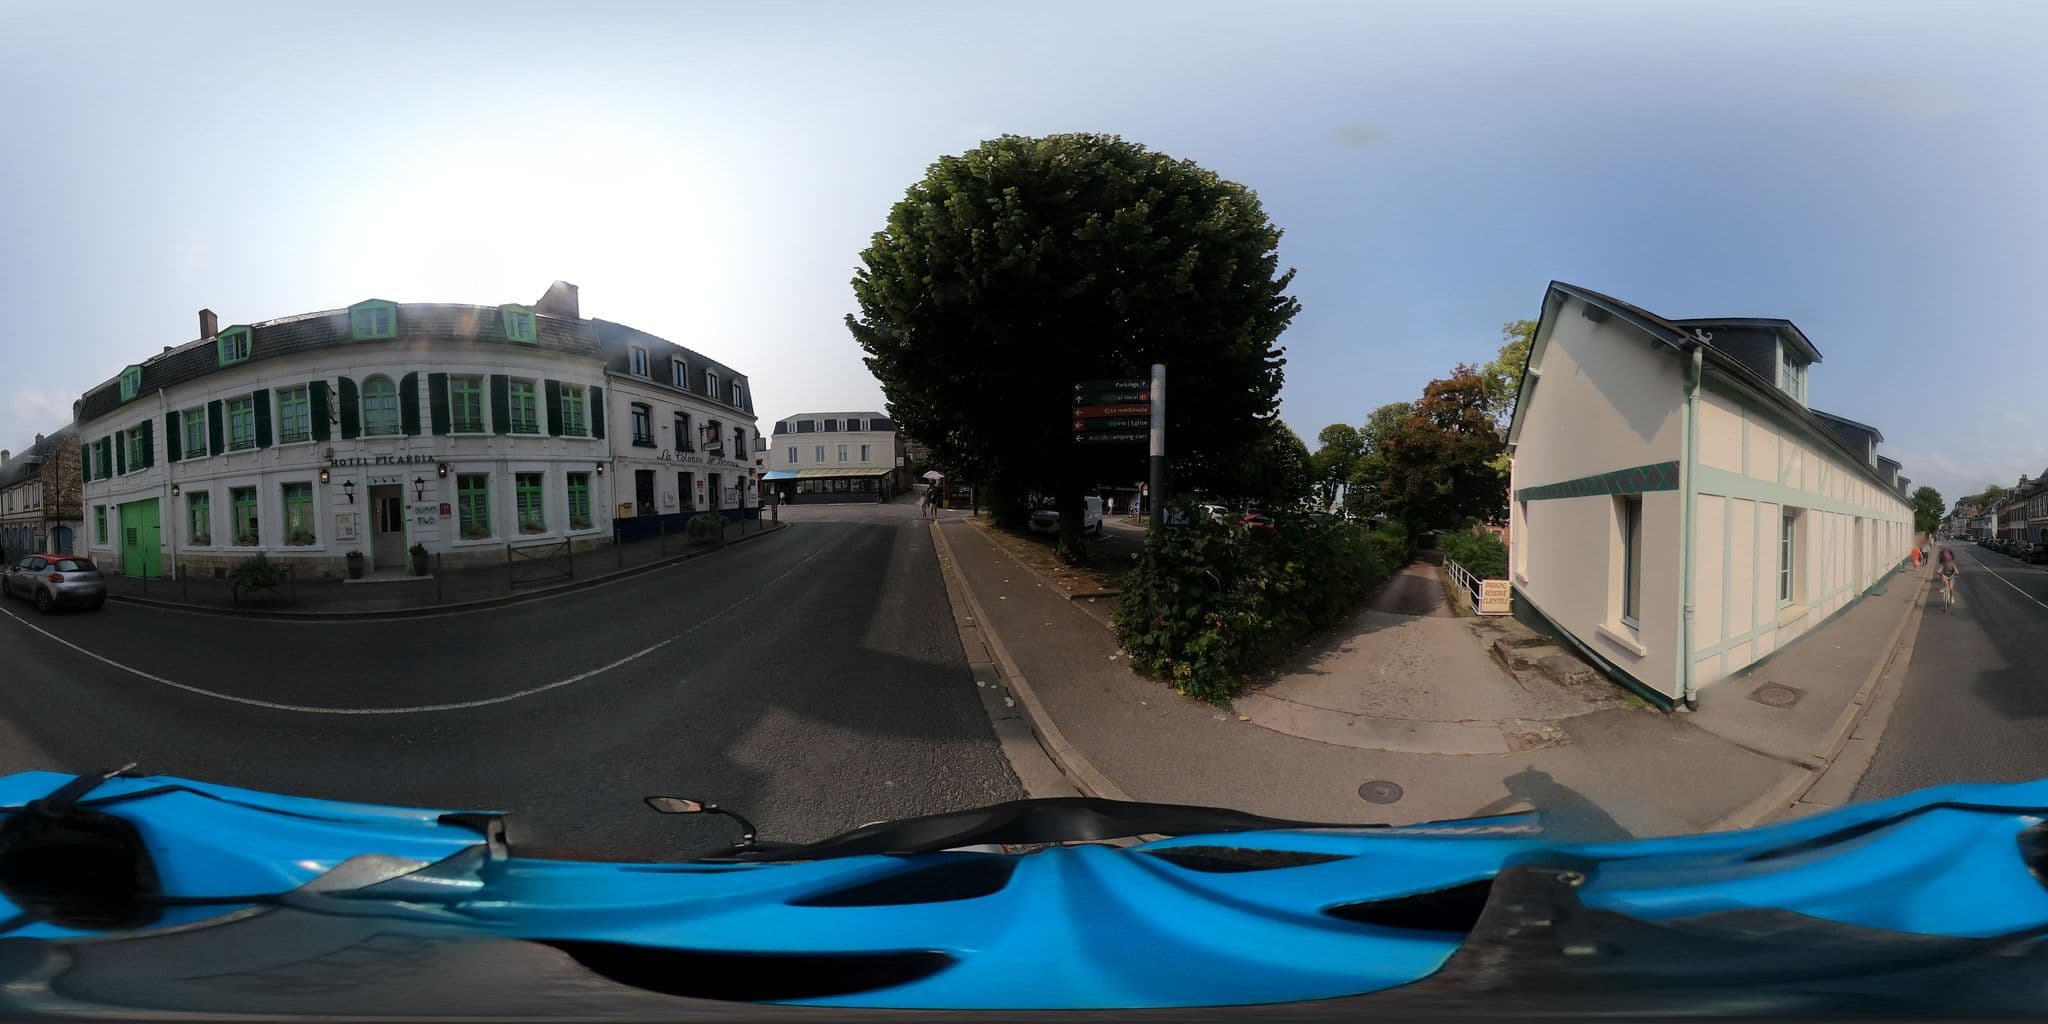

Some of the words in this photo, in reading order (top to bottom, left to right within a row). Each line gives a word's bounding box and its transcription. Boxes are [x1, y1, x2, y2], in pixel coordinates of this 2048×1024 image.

[331, 457, 368, 468] HOTEL
[375, 454, 435, 465] PICARDIA
[656, 448, 671, 462] La
